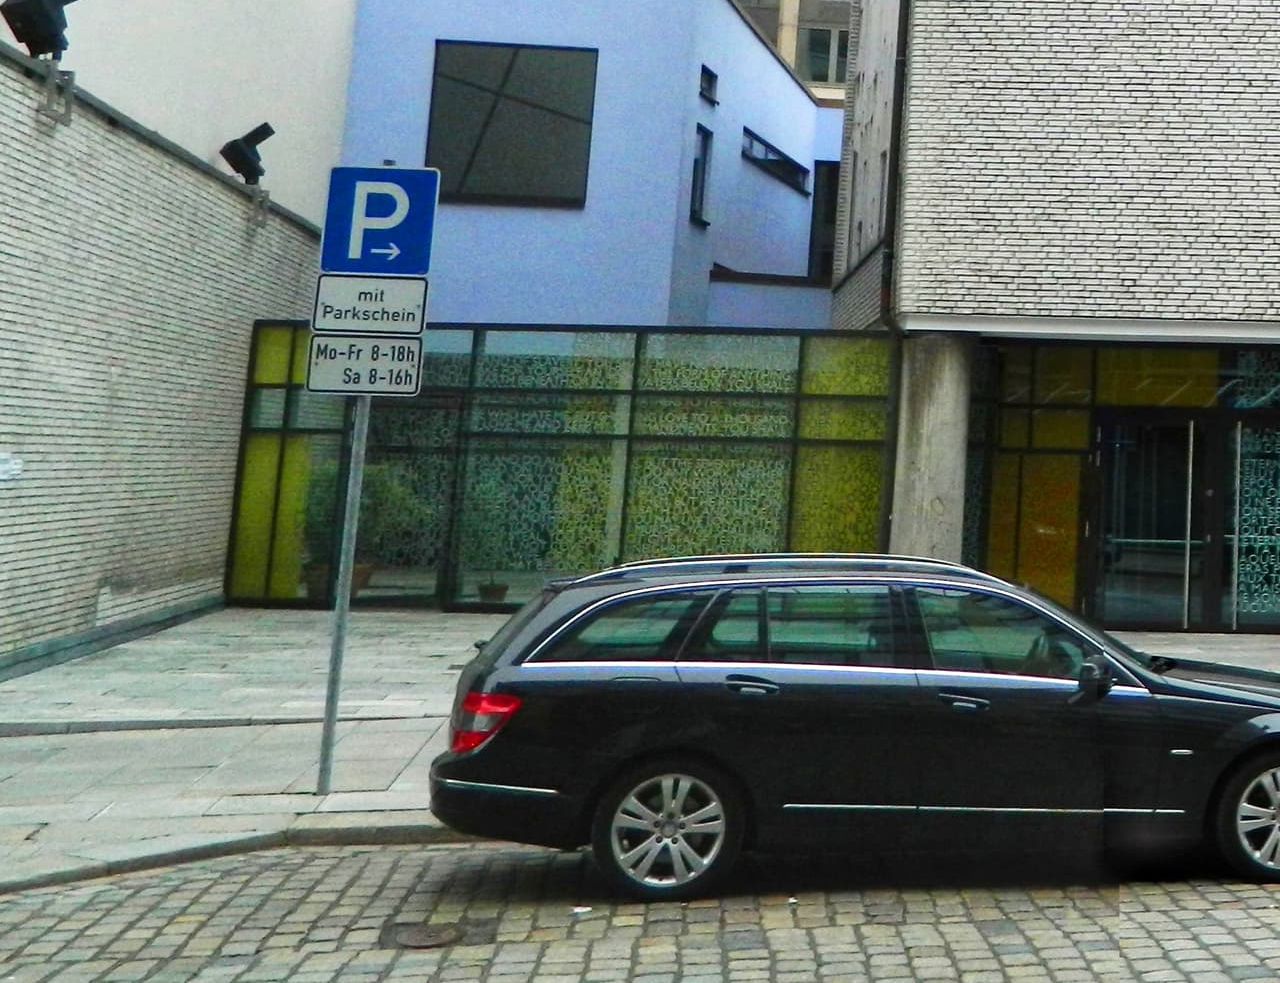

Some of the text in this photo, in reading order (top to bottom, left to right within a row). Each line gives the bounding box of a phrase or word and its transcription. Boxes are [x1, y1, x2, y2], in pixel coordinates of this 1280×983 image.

[348, 181, 411, 259] P
[358, 288, 385, 303] mit
[322, 304, 416, 323] Parkschein
[316, 343, 415, 363] Mo-Fr 8-18h
[342, 368, 413, 387] Sa 8-16h
